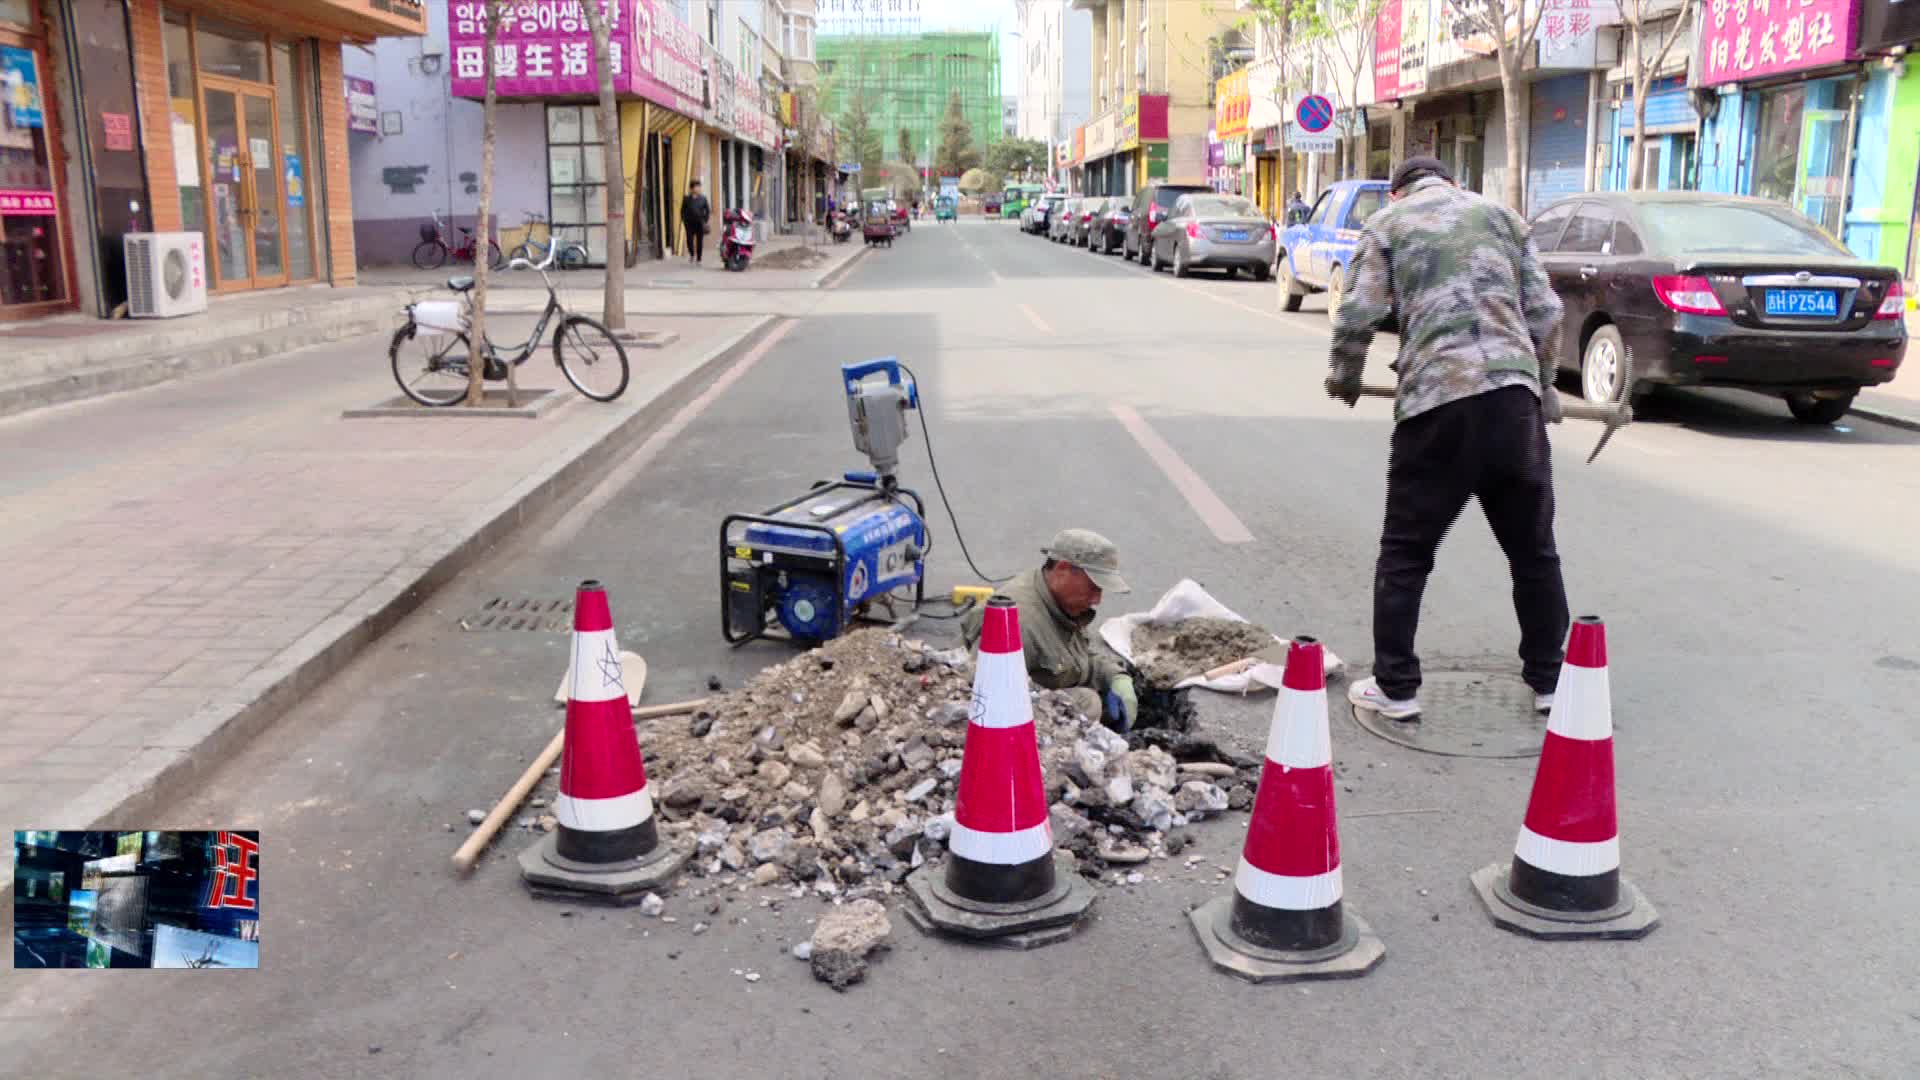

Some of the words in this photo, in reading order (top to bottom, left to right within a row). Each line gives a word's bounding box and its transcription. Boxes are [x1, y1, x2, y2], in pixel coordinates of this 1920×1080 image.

[1709, 11, 1835, 74] 阳光发型社
